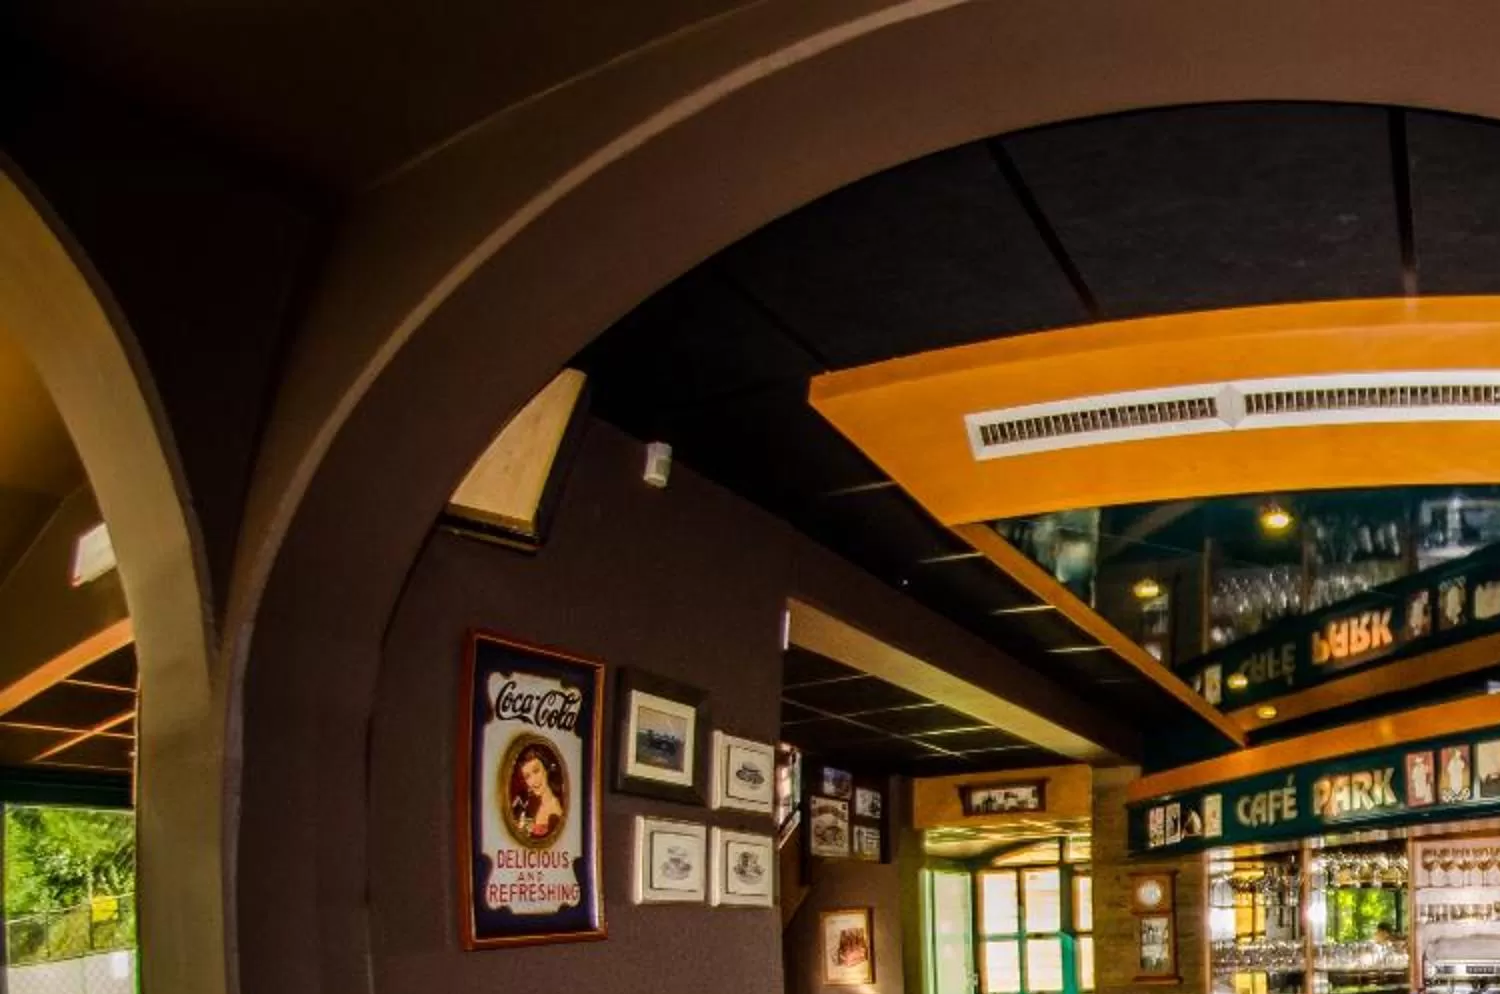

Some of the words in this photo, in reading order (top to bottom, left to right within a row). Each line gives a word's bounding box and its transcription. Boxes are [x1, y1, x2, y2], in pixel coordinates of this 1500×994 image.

[495, 681, 581, 731] Coca-Cola
[1237, 773, 1298, 829] CAFÉ
[1312, 767, 1397, 817] PARK
[497, 848, 570, 869] DELICIOUS
[517, 871, 545, 881] AND
[488, 883, 581, 903] REFRESHING
